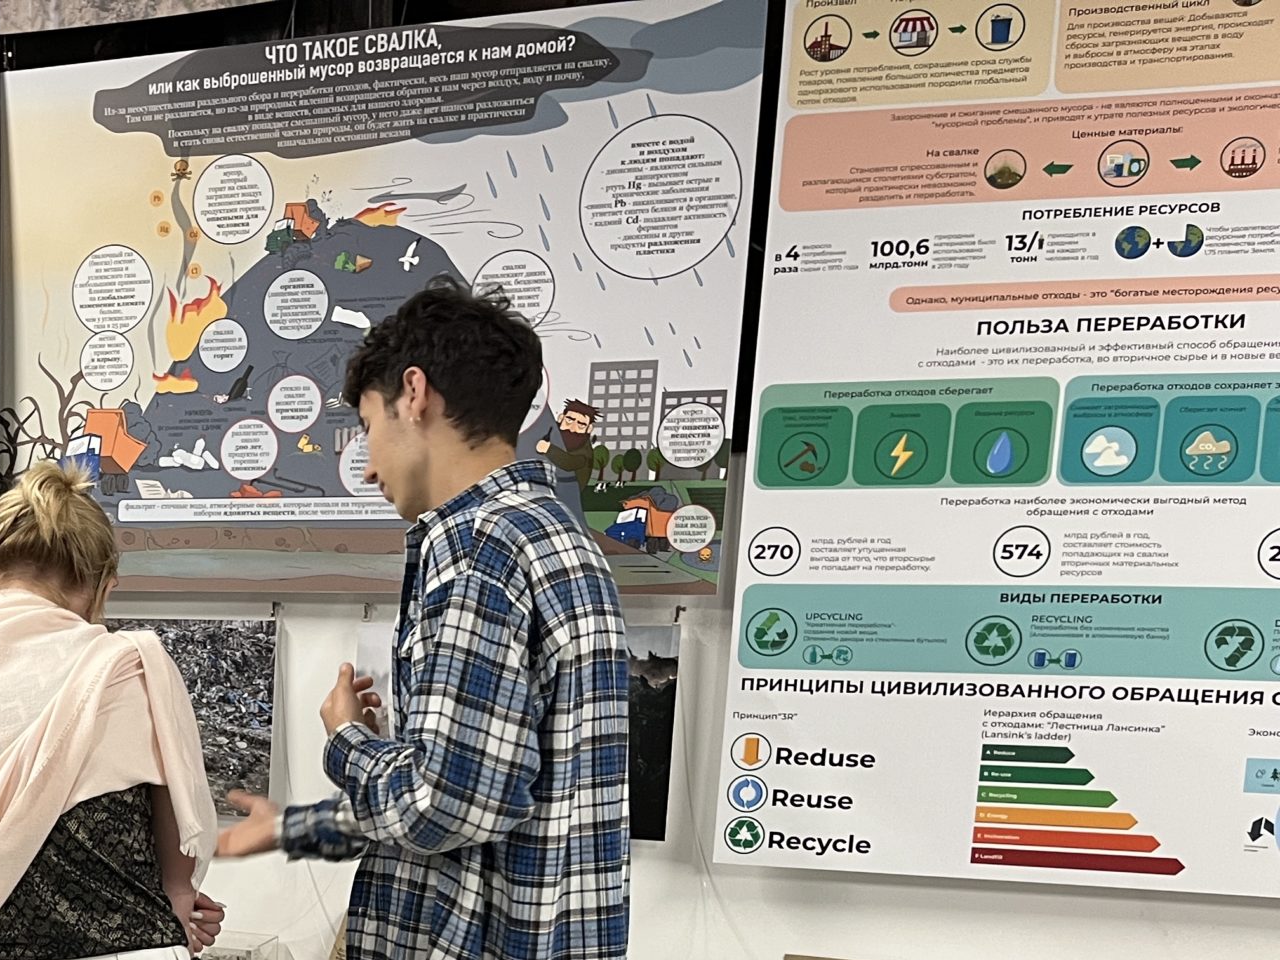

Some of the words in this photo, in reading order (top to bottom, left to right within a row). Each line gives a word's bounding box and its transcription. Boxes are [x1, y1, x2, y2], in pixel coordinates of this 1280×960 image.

[1068, 0, 1178, 16] Производственный
[264, 43, 297, 64] ЧТО
[302, 36, 359, 60] ТАКОЕ
[364, 29, 442, 53] СВАЛКА,
[148, 81, 172, 95] или
[176, 78, 200, 92] как
[203, 64, 305, 89] выброшенный
[309, 62, 354, 81] мусор
[358, 50, 464, 72] возвращается
[468, 48, 477, 61] к
[482, 45, 512, 59] нам
[515, 35, 575, 58] домой?
[1071, 130, 1115, 139] Ценные
[1118, 126, 1183, 136] материалы:
[926, 149, 940, 157] На
[942, 148, 979, 156] свалке
[1022, 205, 1134, 220] ПОТРЕБЛЕНИЕ
[1138, 202, 1220, 215] РЕСУРСОВ
[785, 245, 800, 261] 4
[870, 238, 930, 259] 100,6
[869, 259, 928, 271] млрд.тонн
[1010, 255, 1037, 263] тонн
[773, 265, 798, 275] раза
[905, 296, 948, 305] Однако,
[950, 293, 1039, 304] муниципальные
[1110, 288, 1159, 297] "богатые
[1162, 287, 1253, 296] месторождения
[976, 318, 1069, 335] ПОЛЬЗА
[1076, 314, 1245, 332] ПЕРЕРАБОТКИ
[935, 346, 989, 355] Наиболее
[991, 343, 1085, 354] цивилизованный
[1098, 341, 1174, 352] эффективный
[1176, 339, 1216, 349] способ
[925, 359, 976, 367] отходами
[1021, 355, 1094, 365] переработка,
[1112, 354, 1171, 362] вторичное
[1173, 353, 1208, 362] сырье
[823, 389, 892, 399] Переработка
[938, 386, 993, 395] сберегает
[1091, 382, 1164, 392] Переработка
[1213, 382, 1272, 390] сохраняет
[940, 496, 1011, 506] Переработка
[1013, 496, 1066, 504] наиболее
[1152, 496, 1210, 504] выгодный
[1212, 497, 1246, 505] метод
[1026, 507, 1089, 517] обращения
[754, 545, 794, 560] 270
[1000, 544, 1044, 560] 574
[999, 593, 1046, 604] ВИДЫ
[1050, 593, 1162, 604] ПЕРЕРАБОТКИ
[805, 613, 863, 621] UPCYCLING
[1031, 615, 1093, 624] RECYCLING
[740, 677, 864, 694] ПРИНЦИПЫ
[870, 681, 1105, 699] ЦИВИЛИЗОВАННОГО
[1112, 686, 1264, 704] ОБРАЩЕНИЯ
[983, 709, 1036, 718] Иерархия
[1038, 710, 1102, 719] обращения
[990, 721, 1044, 729] отходами:
[1046, 721, 1103, 731] "Лестница
[1105, 723, 1166, 733] Лансинка"
[981, 730, 1032, 739] (Lansink's
[1034, 732, 1071, 742] ladder)
[775, 747, 876, 768] Reduse
[771, 789, 853, 810] Reuse
[768, 831, 871, 856] Recycle
